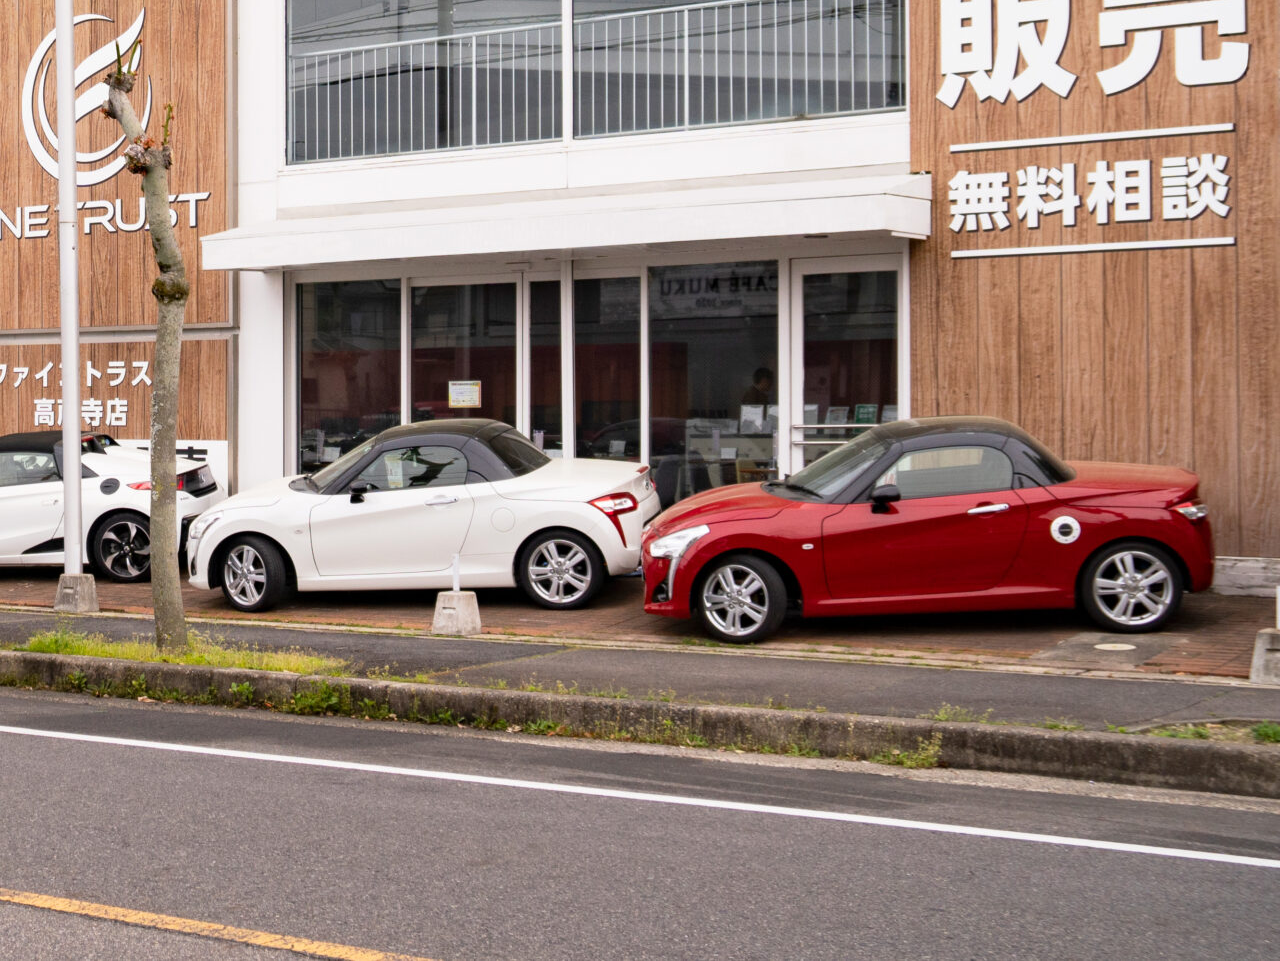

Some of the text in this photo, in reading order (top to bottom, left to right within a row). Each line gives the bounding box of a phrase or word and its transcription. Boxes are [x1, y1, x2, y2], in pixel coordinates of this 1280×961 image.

[54, 192, 211, 234] RUT
[948, 152, 1230, 233] 無料相談
[33, 397, 128, 427] 高寺店
